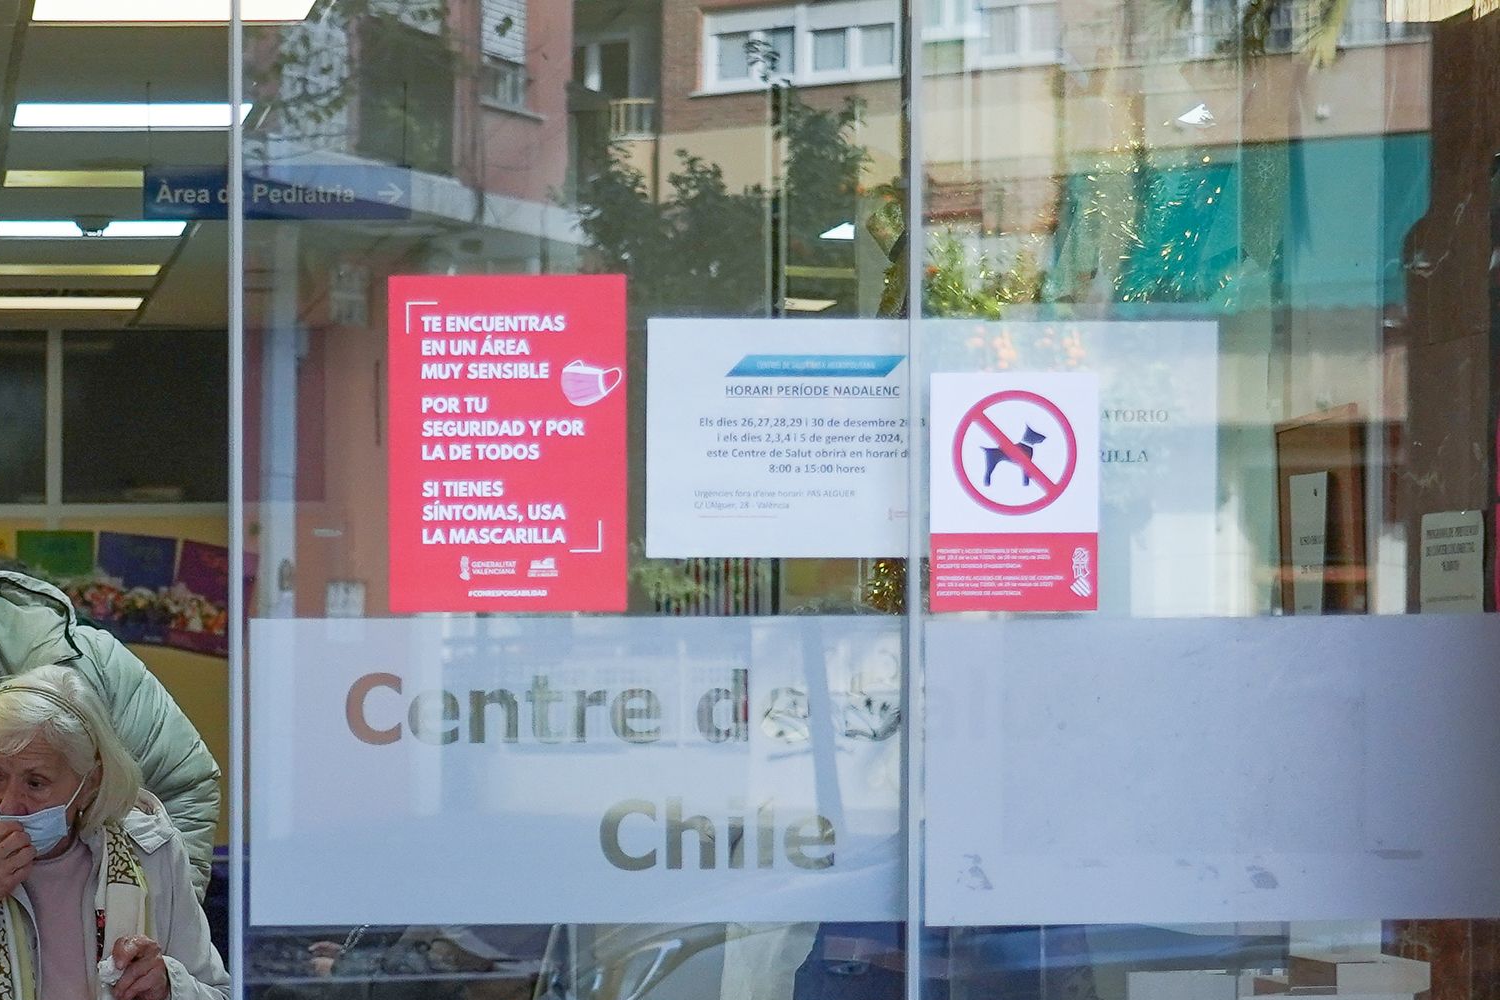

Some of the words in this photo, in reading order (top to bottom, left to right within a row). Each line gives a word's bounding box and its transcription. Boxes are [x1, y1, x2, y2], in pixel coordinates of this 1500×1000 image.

[421, 315, 441, 332] TE
[446, 315, 565, 332] ENCUENTRAS
[421, 340, 447, 356] EN
[450, 340, 476, 356] UN
[480, 335, 530, 355] ÁREA
[421, 363, 464, 379] MUY
[467, 363, 549, 379] SENSIBLE
[725, 385, 773, 396] HORARI
[777, 383, 829, 396] PERÍODE
[833, 385, 900, 396] NADALENC
[421, 397, 460, 413] POR
[464, 397, 487, 413] TU
[422, 420, 525, 437] SEGURIDAD
[528, 420, 542, 437] Y
[546, 420, 584, 437] POR
[700, 418, 713, 427] Els
[717, 418, 737, 427] dies
[741, 418, 802, 429] 26,27,28,29
[812, 418, 824, 427] 30
[827, 418, 840, 427] de
[843, 418, 897, 427] desembre
[723, 434, 737, 443] els
[741, 434, 762, 443] dies
[765, 434, 790, 445] 2,3,4
[800, 434, 806, 443] 5
[809, 434, 822, 443] de
[825, 436, 855, 445] gener
[858, 434, 871, 443] de
[422, 444, 445, 461] LA
[449, 444, 471, 461] DE
[475, 444, 540, 461] TODOS
[706, 449, 728, 458] este
[731, 449, 766, 458] Centre
[769, 449, 782, 458] de
[786, 449, 812, 458] Salut
[815, 449, 847, 458] obrirà
[850, 450, 862, 458] en
[865, 449, 898, 458] horari
[769, 464, 791, 474] 8:00
[804, 464, 833, 474] 15:00
[836, 464, 865, 474] hores
[422, 481, 439, 497] SI
[443, 481, 504, 497] TIENES
[823, 490, 856, 498] ALGUER
[422, 500, 524, 523] SÍNTOMAS,
[528, 504, 566, 520] USA
[422, 528, 446, 544] LA
[450, 528, 566, 544] MASCARILLA
[345, 672, 662, 745] Centre
[600, 798, 836, 870] Chile
